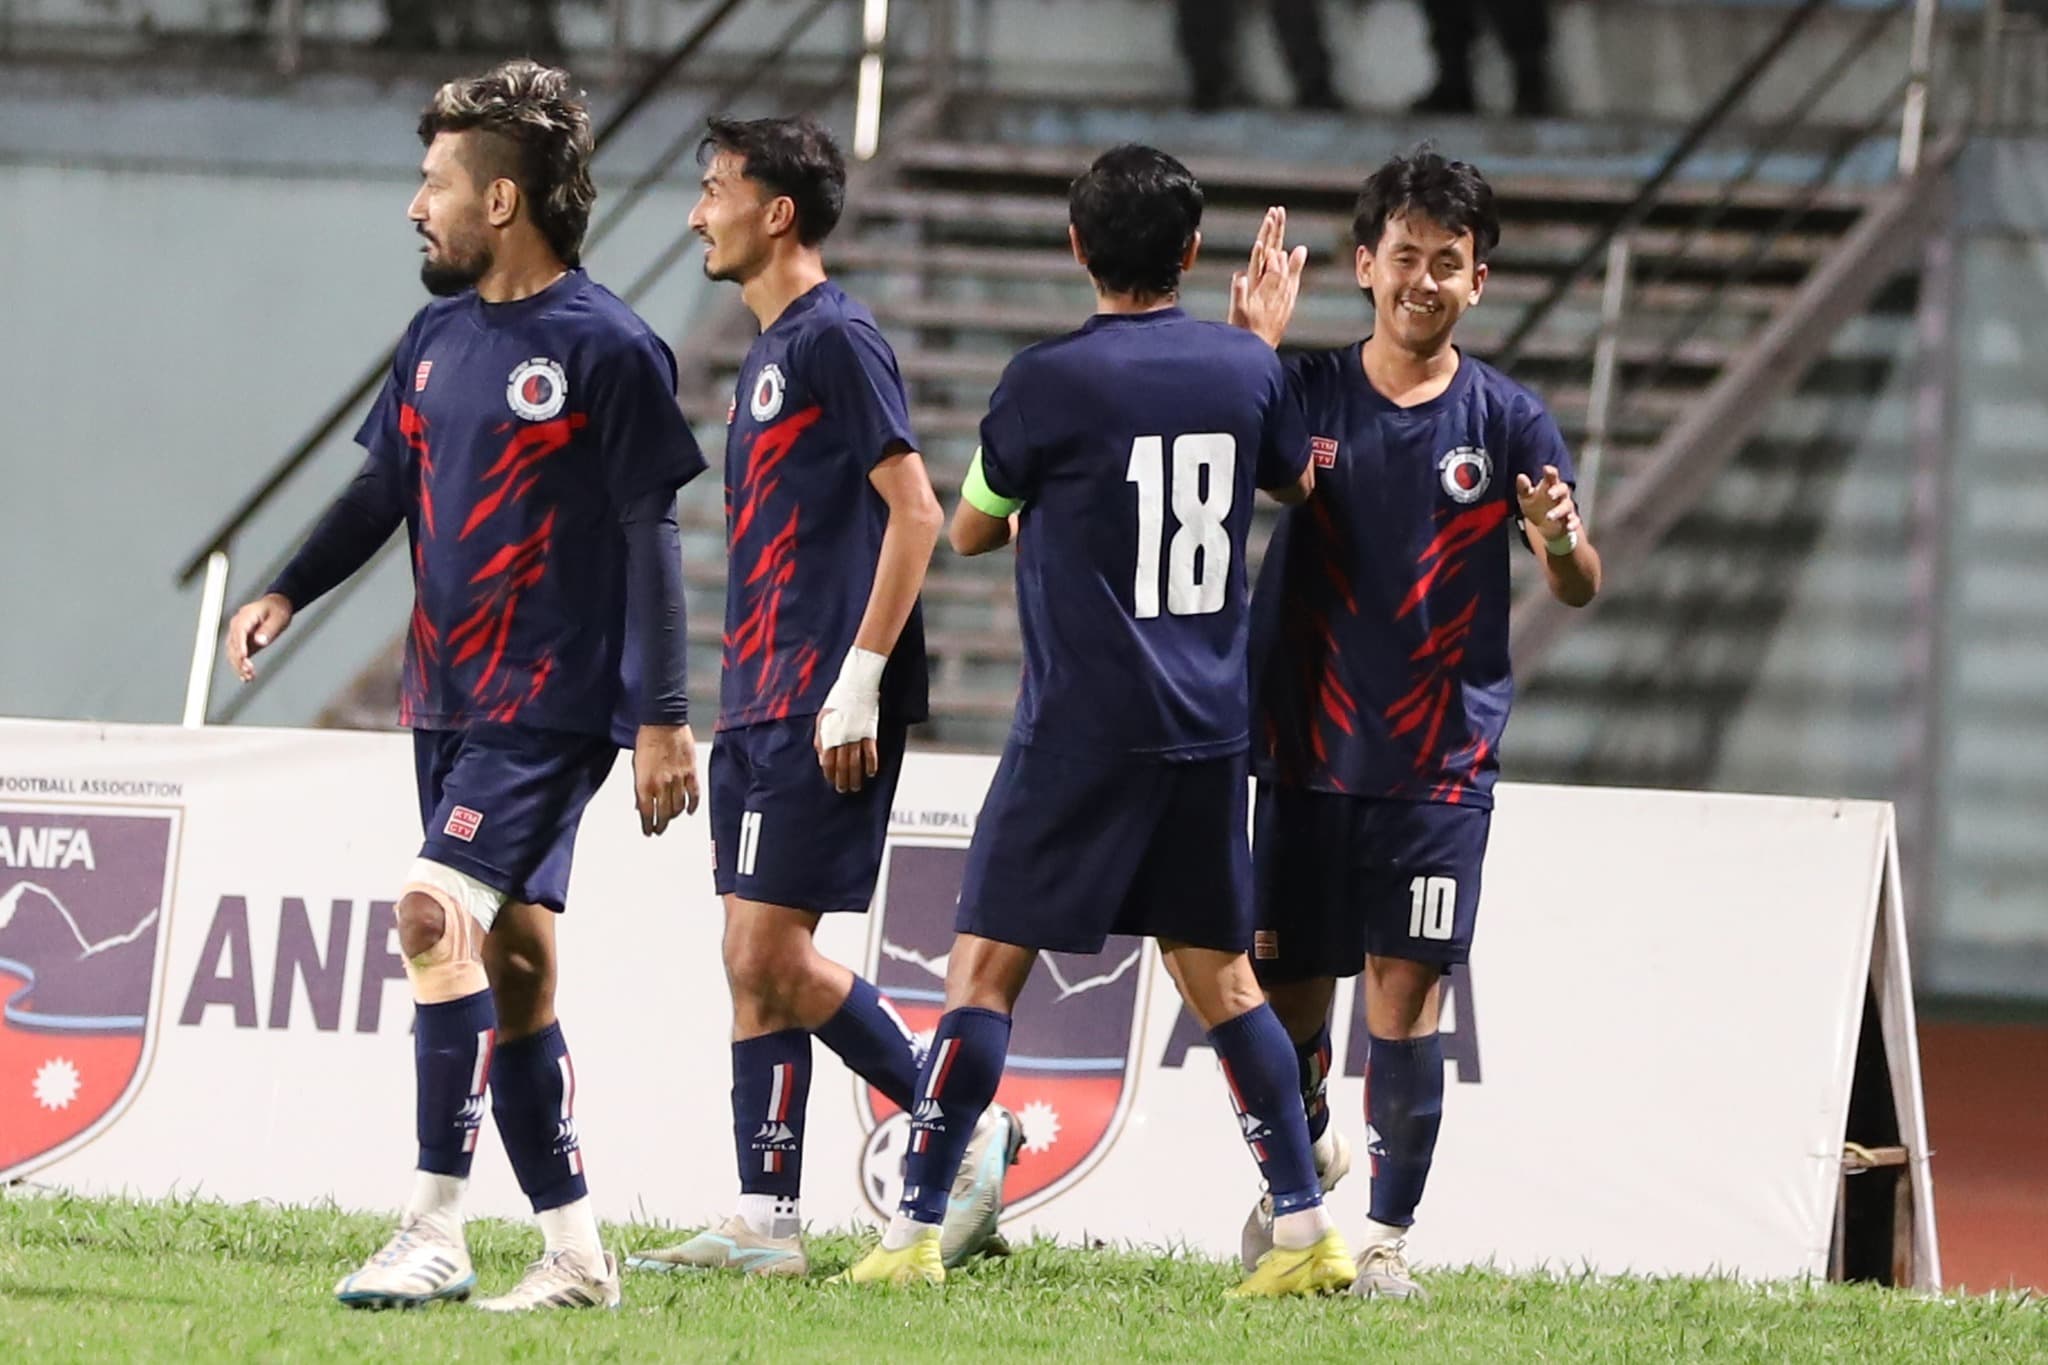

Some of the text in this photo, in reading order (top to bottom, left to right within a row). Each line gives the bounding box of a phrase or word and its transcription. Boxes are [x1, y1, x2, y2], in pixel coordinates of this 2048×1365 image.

[1125, 433, 1237, 619] 18
[80, 780, 183, 797] ASSOCIATION
[920, 811, 968, 828] NEPAL
[737, 810, 763, 875] 11
[1408, 876, 1457, 940] 10
[178, 894, 415, 1034] ANF
